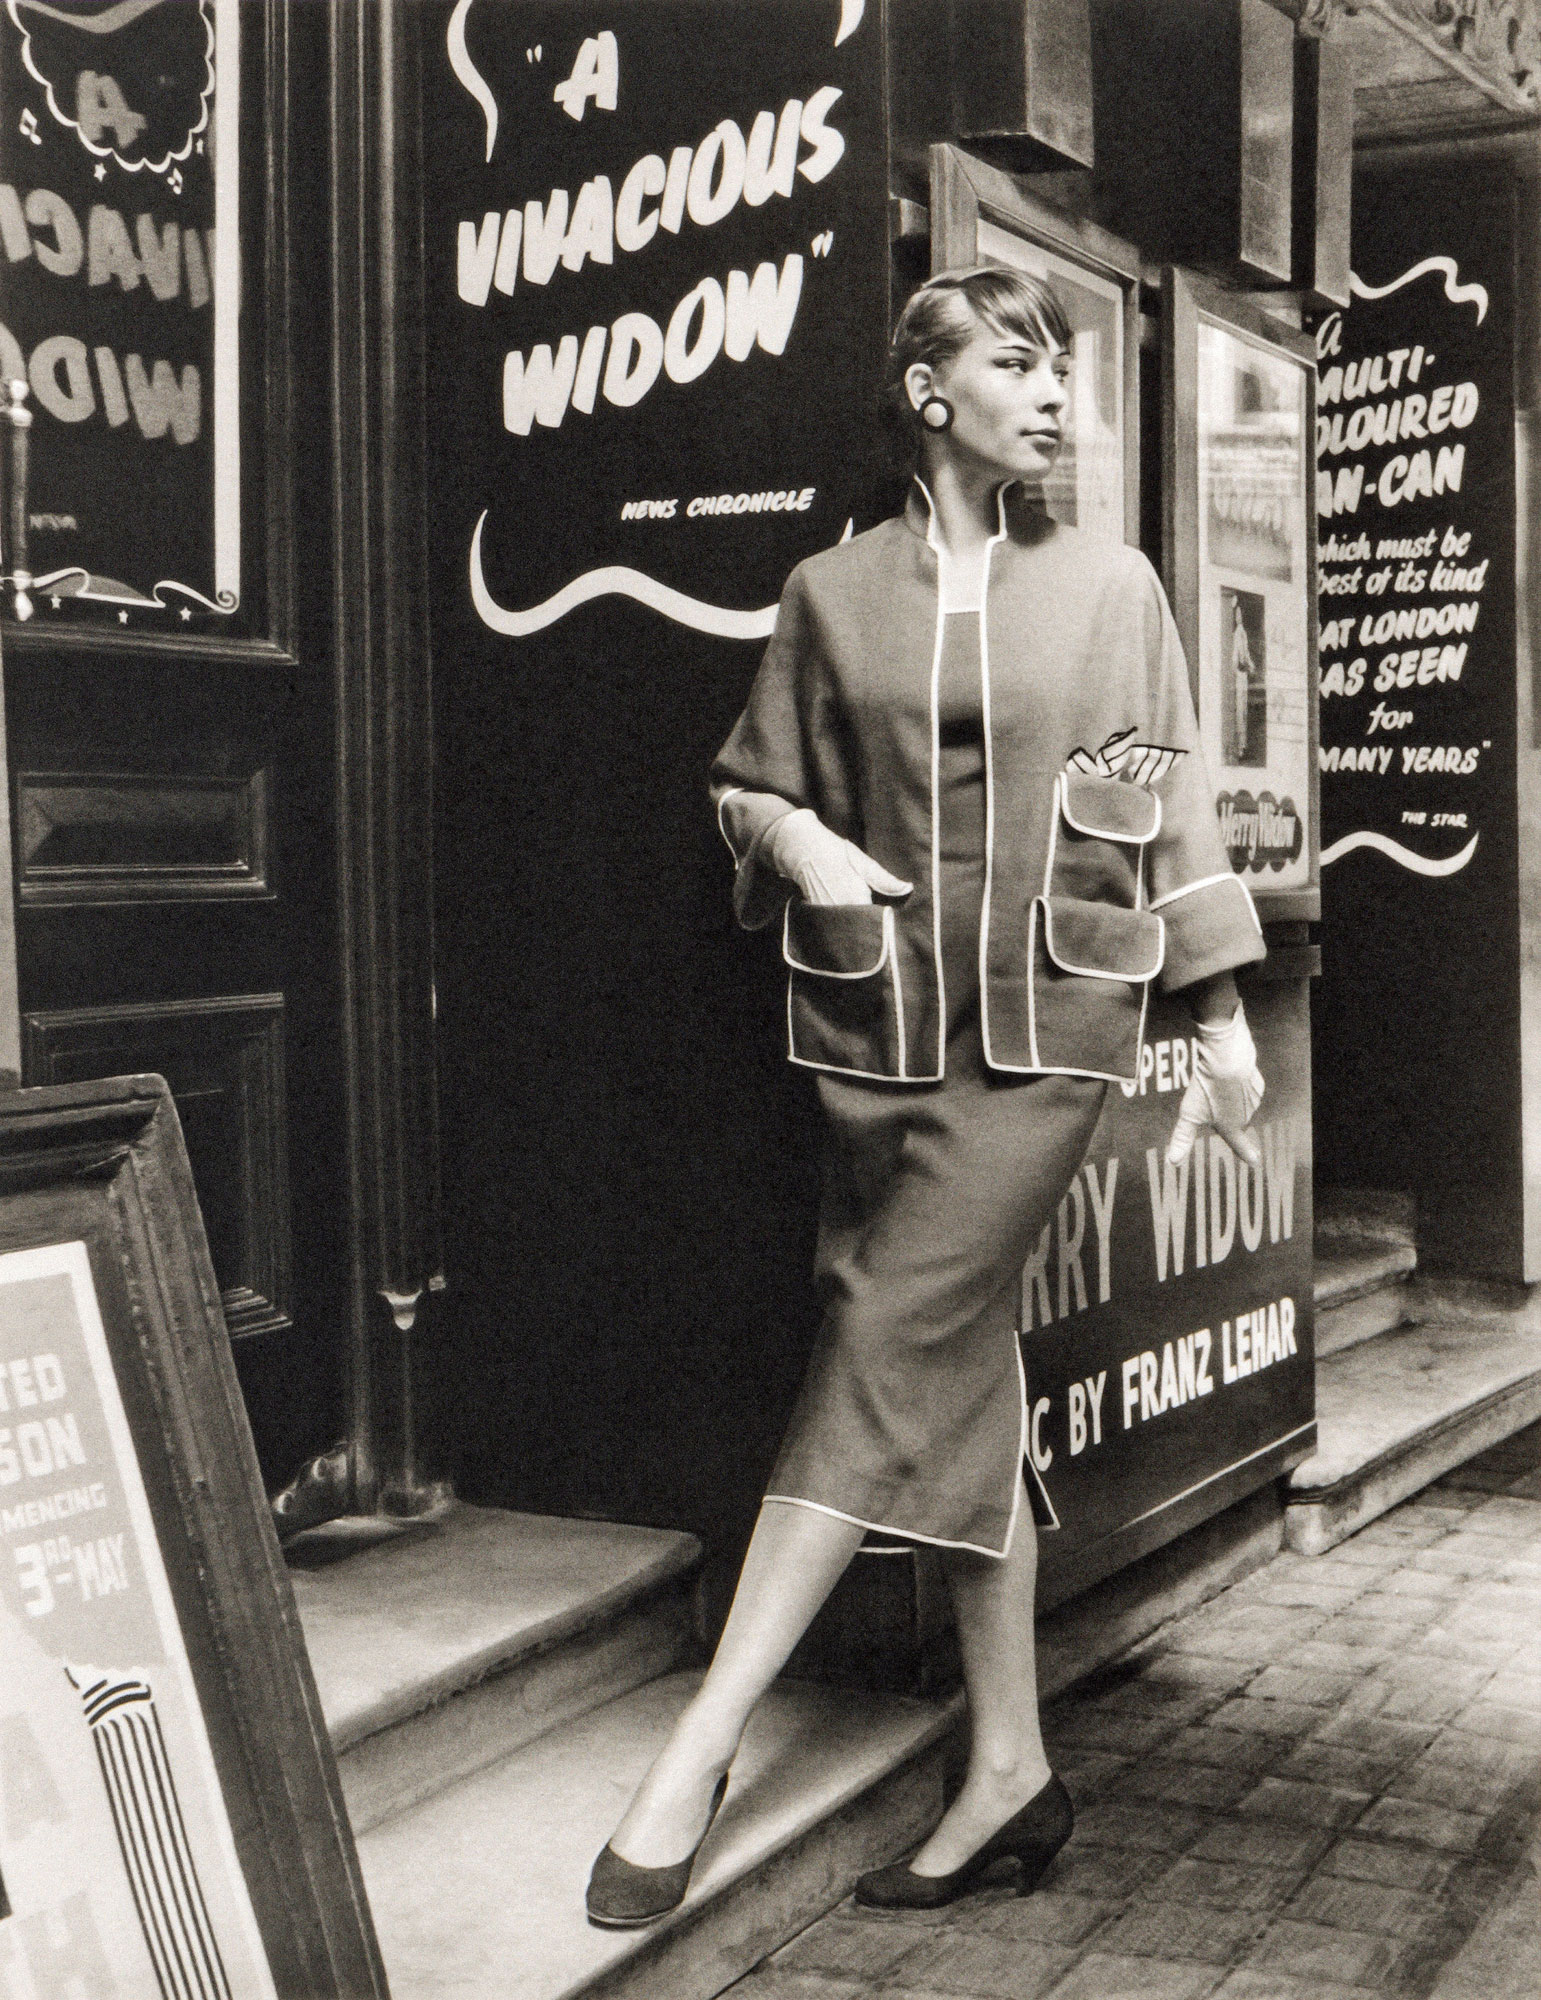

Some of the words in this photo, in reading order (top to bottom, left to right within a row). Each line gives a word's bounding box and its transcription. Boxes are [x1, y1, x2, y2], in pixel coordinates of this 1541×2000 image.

[458, 86, 845, 307] VIVACIOUS
[621, 499, 679, 521] NEWS
[686, 488, 816, 518] CHRONICLE
[1376, 529, 1438, 559] must
[1440, 525, 1472, 557] be
[1365, 566, 1392, 595] of
[1394, 561, 1427, 593] its
[1429, 559, 1489, 592] kind
[1359, 601, 1479, 647] LONDON
[1373, 643, 1468, 693] SEEN
[1366, 701, 1414, 735] for
[1146, 1124, 1297, 1283] WIDOW
[1068, 1371, 1107, 1456] BY
[1122, 1328, 1214, 1430] FRANZ
[1221, 1297, 1297, 1385] LEHAR
